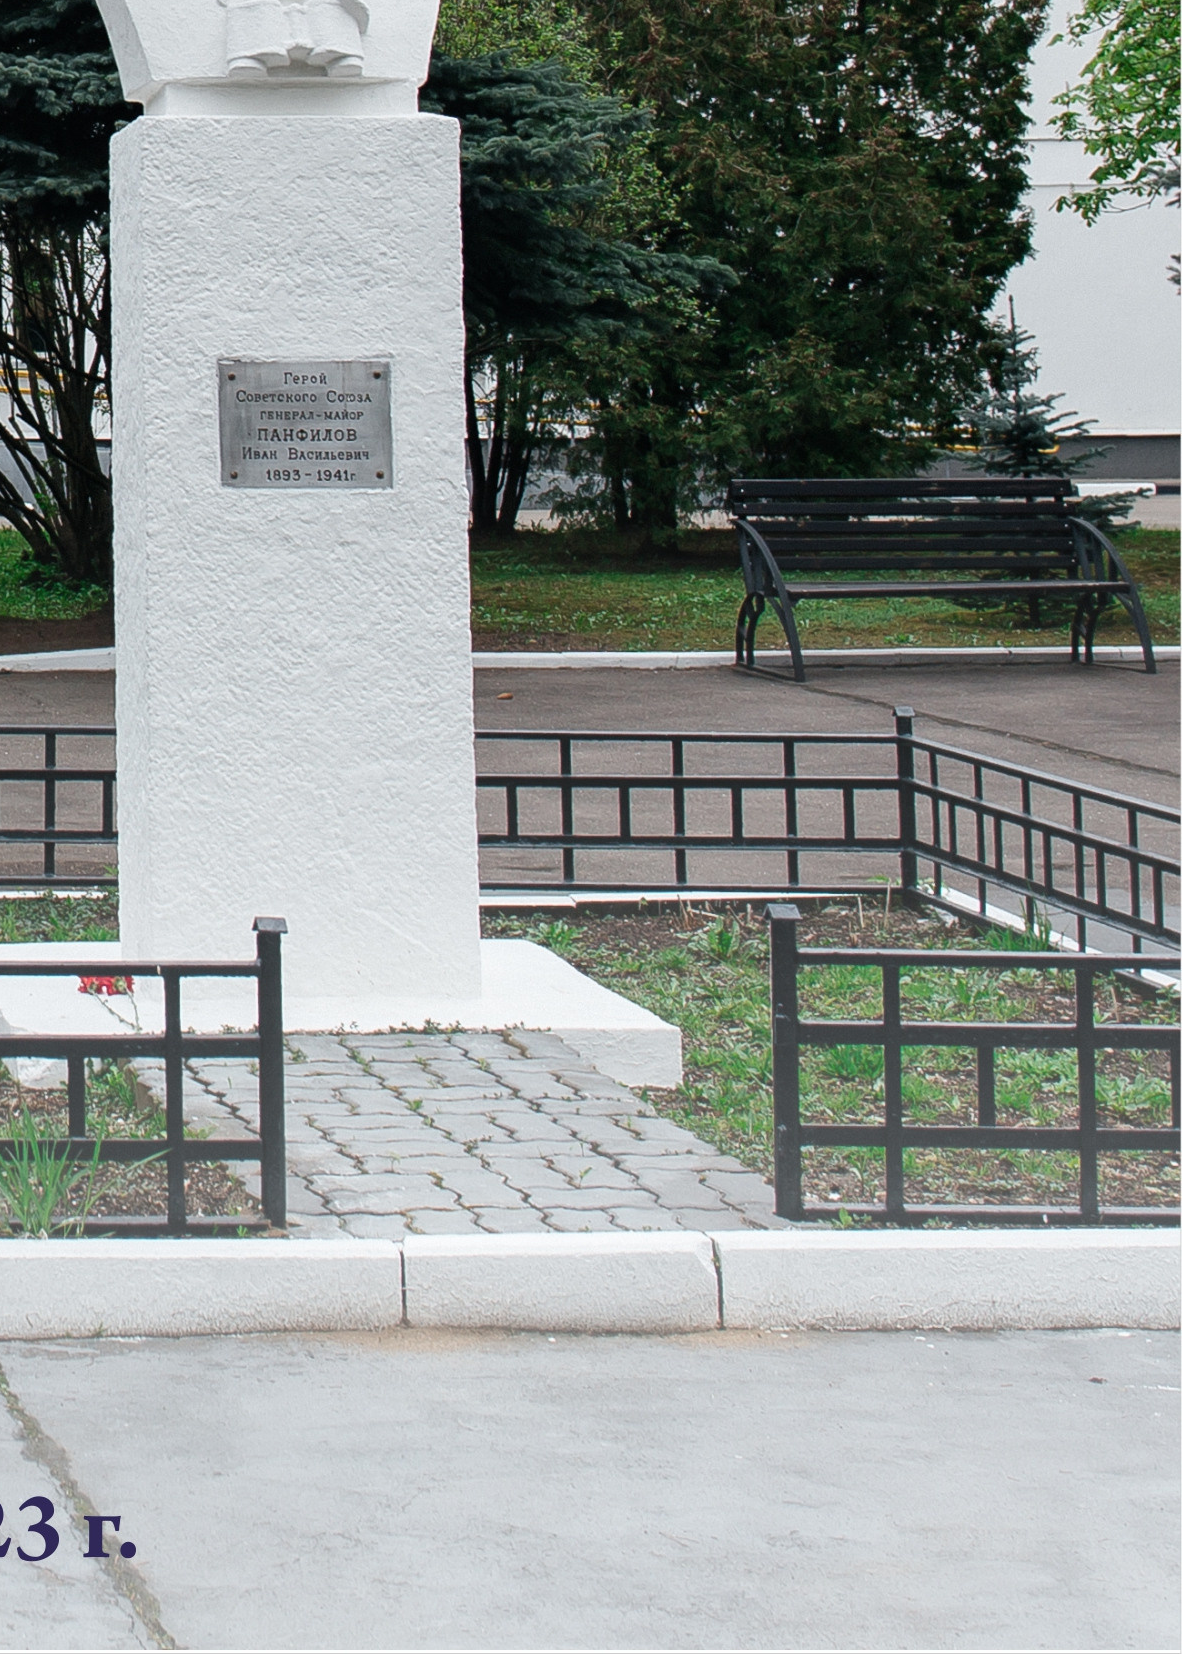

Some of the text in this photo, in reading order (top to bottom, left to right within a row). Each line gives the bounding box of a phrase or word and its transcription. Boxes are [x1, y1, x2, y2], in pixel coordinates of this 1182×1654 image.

[283, 372, 328, 385] Герой
[236, 390, 372, 403] Советского Союза
[257, 428, 358, 442] ПАНФИЛОВ
[242, 447, 370, 460] Иван Васильевич
